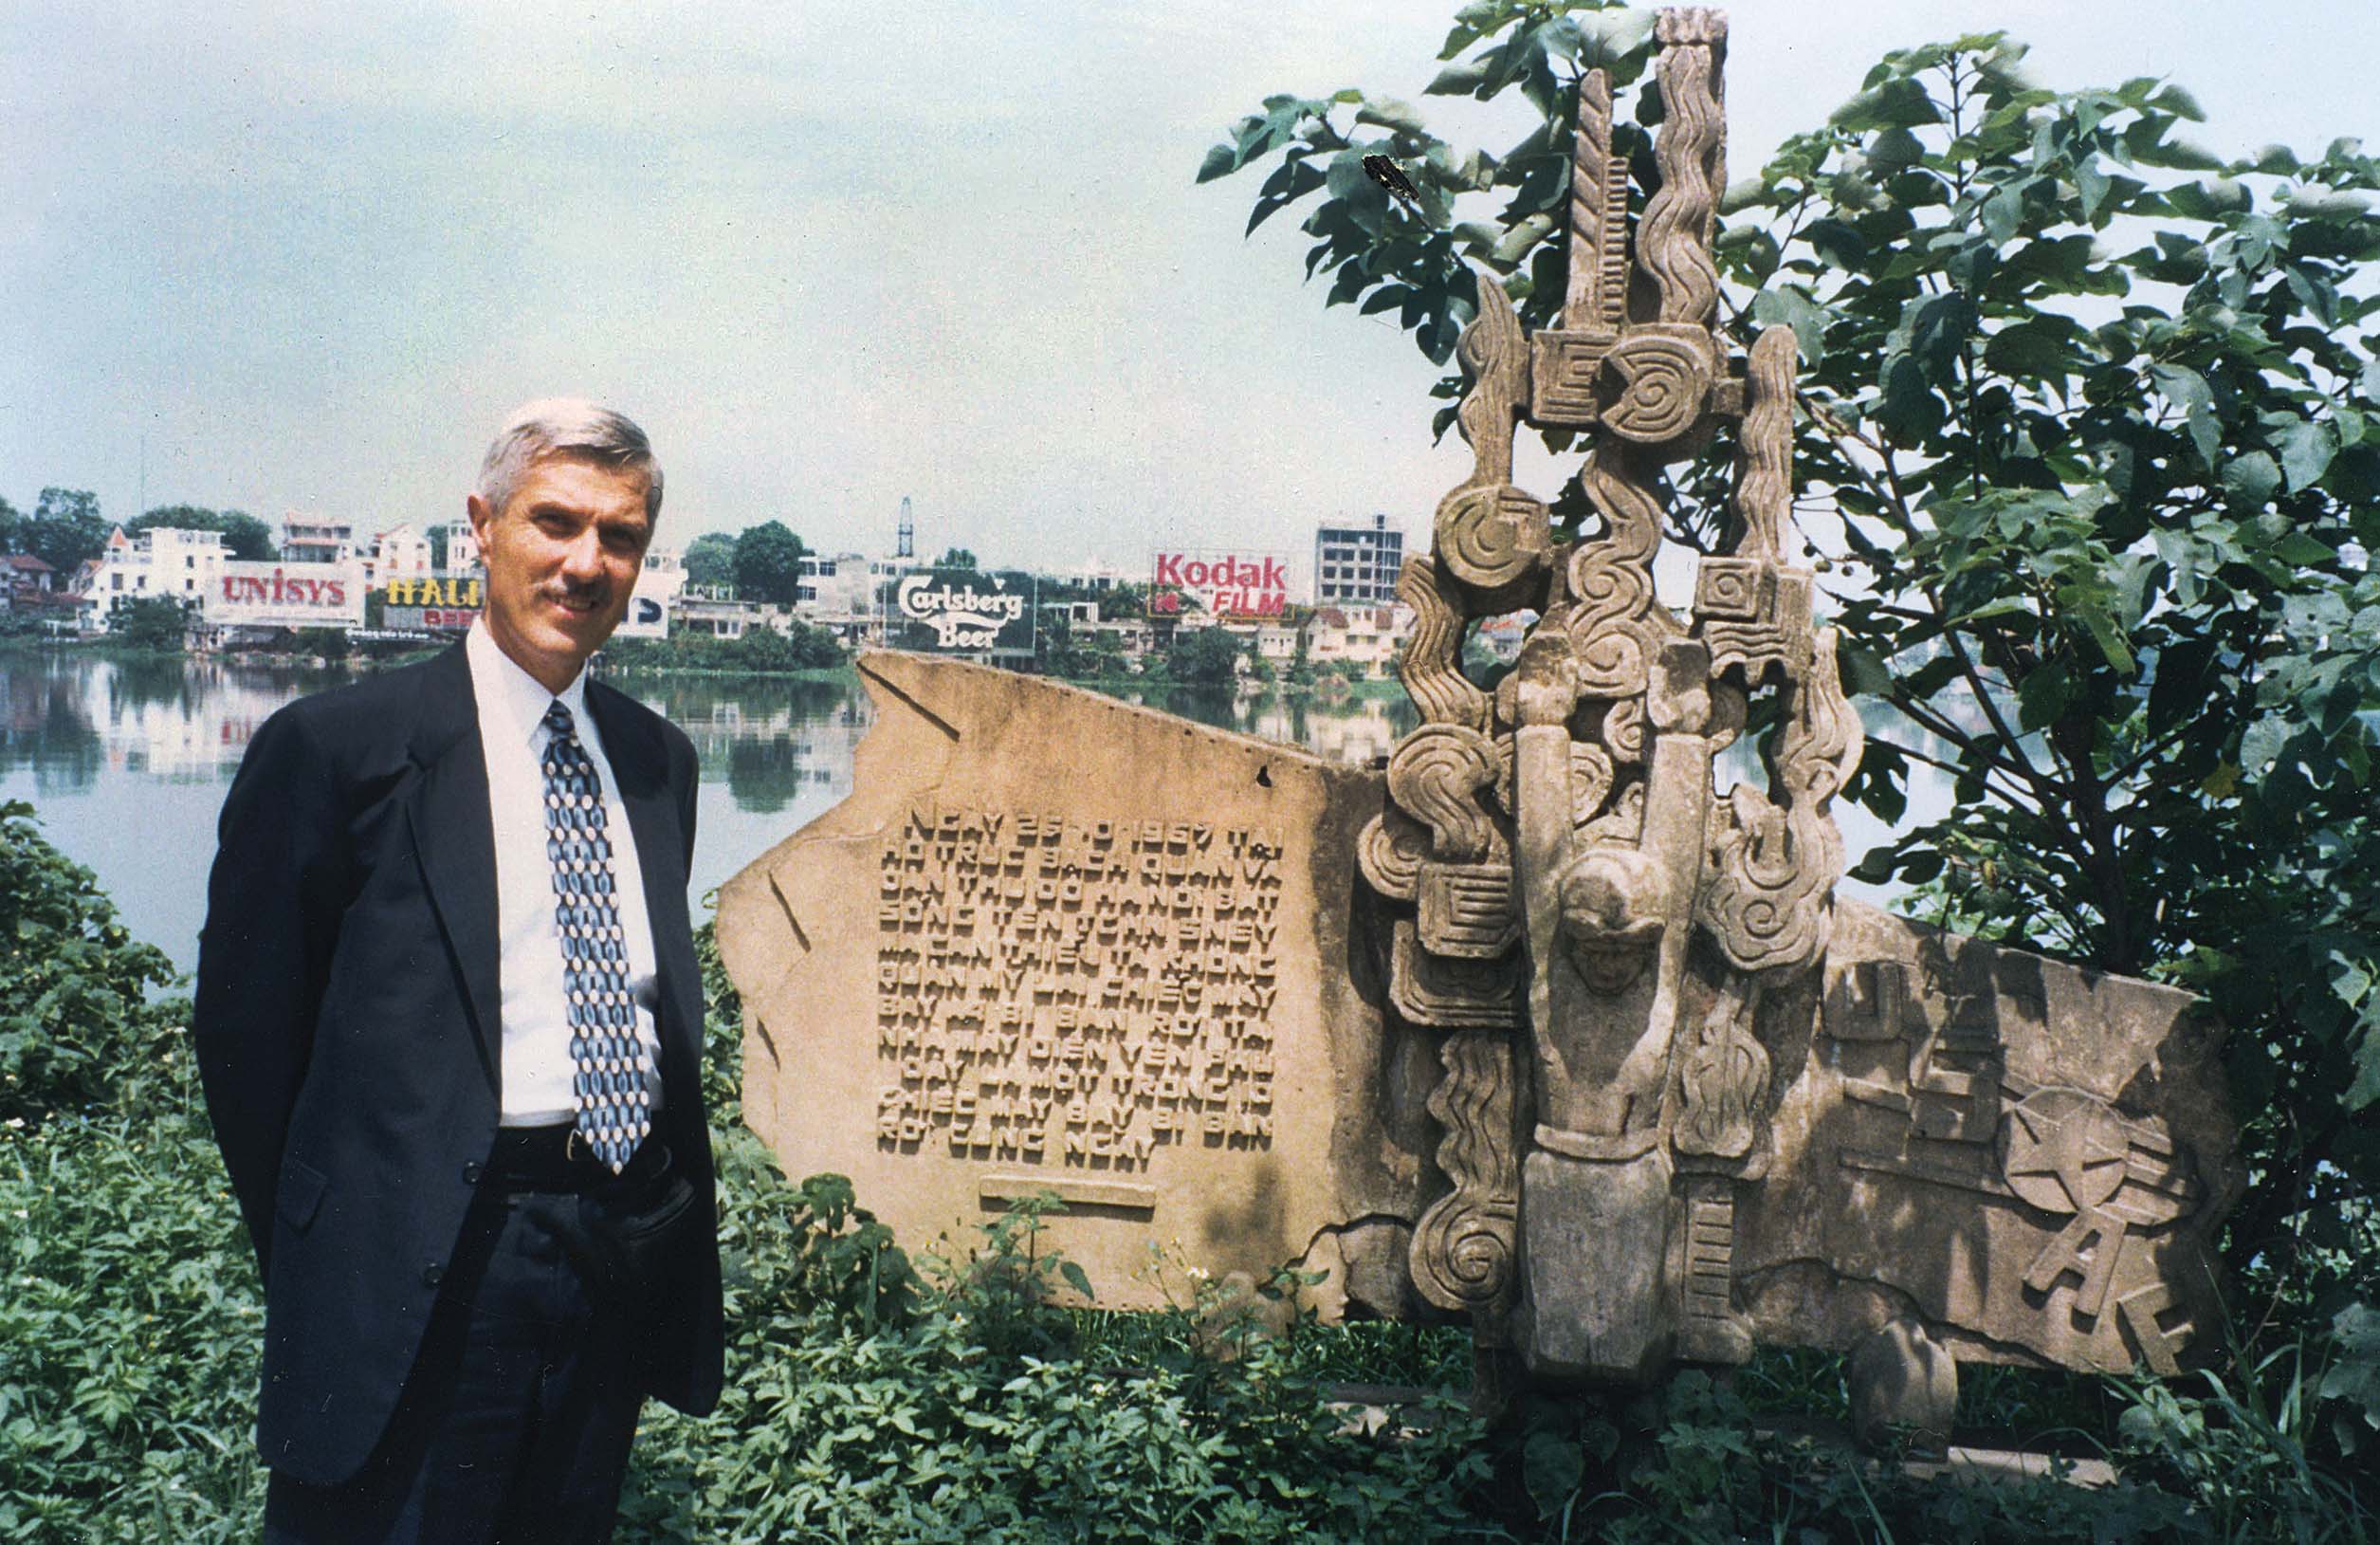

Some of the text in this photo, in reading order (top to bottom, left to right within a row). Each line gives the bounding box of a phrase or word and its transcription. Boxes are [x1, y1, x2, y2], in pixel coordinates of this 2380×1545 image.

[1157, 554, 1286, 589] Kodak
[387, 578, 481, 606] HALI
[898, 575, 1024, 619] Carlsberg
[1213, 591, 1285, 615] FILM
[423, 609, 482, 625] BEE
[937, 621, 999, 648] Beer
